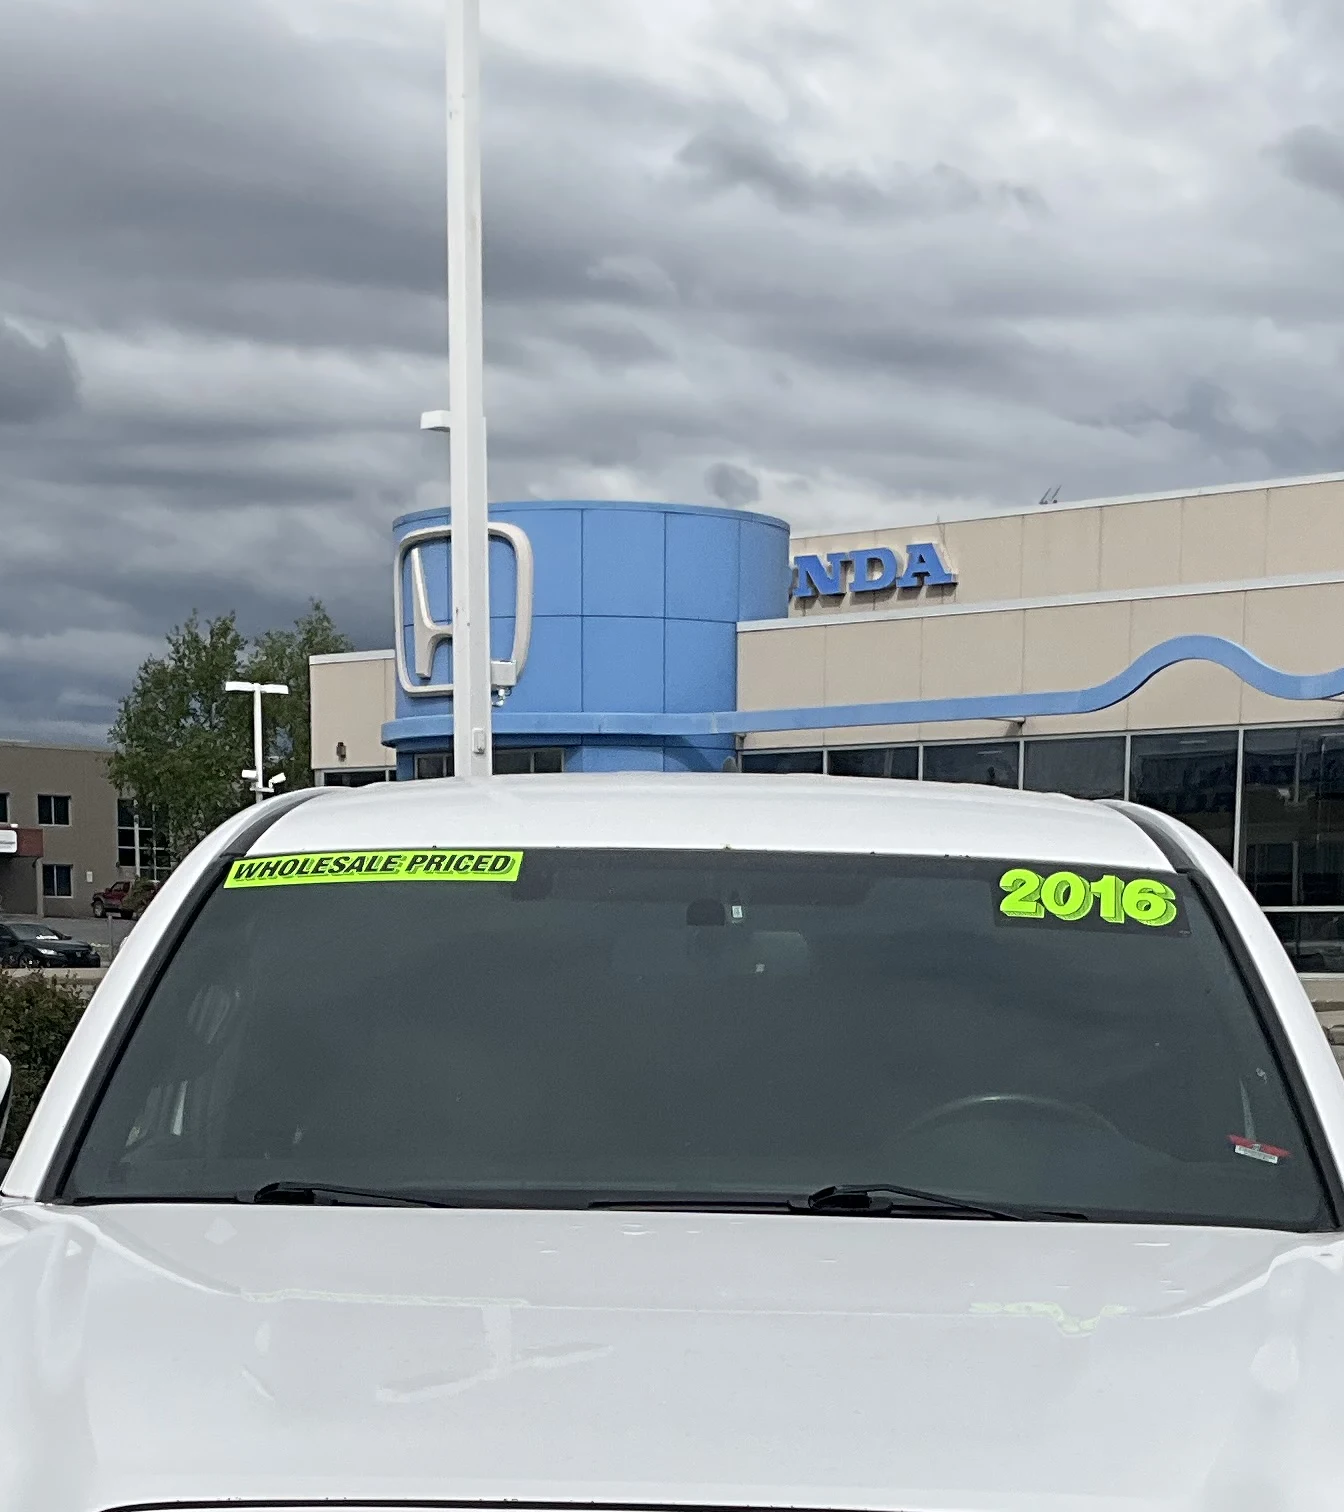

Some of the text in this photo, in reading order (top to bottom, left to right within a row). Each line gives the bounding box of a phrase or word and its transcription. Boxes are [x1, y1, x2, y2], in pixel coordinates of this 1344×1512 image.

[788, 542, 954, 598] NDA
[233, 854, 515, 881] WHOLESALE PRICED
[999, 868, 1177, 926] 2016
